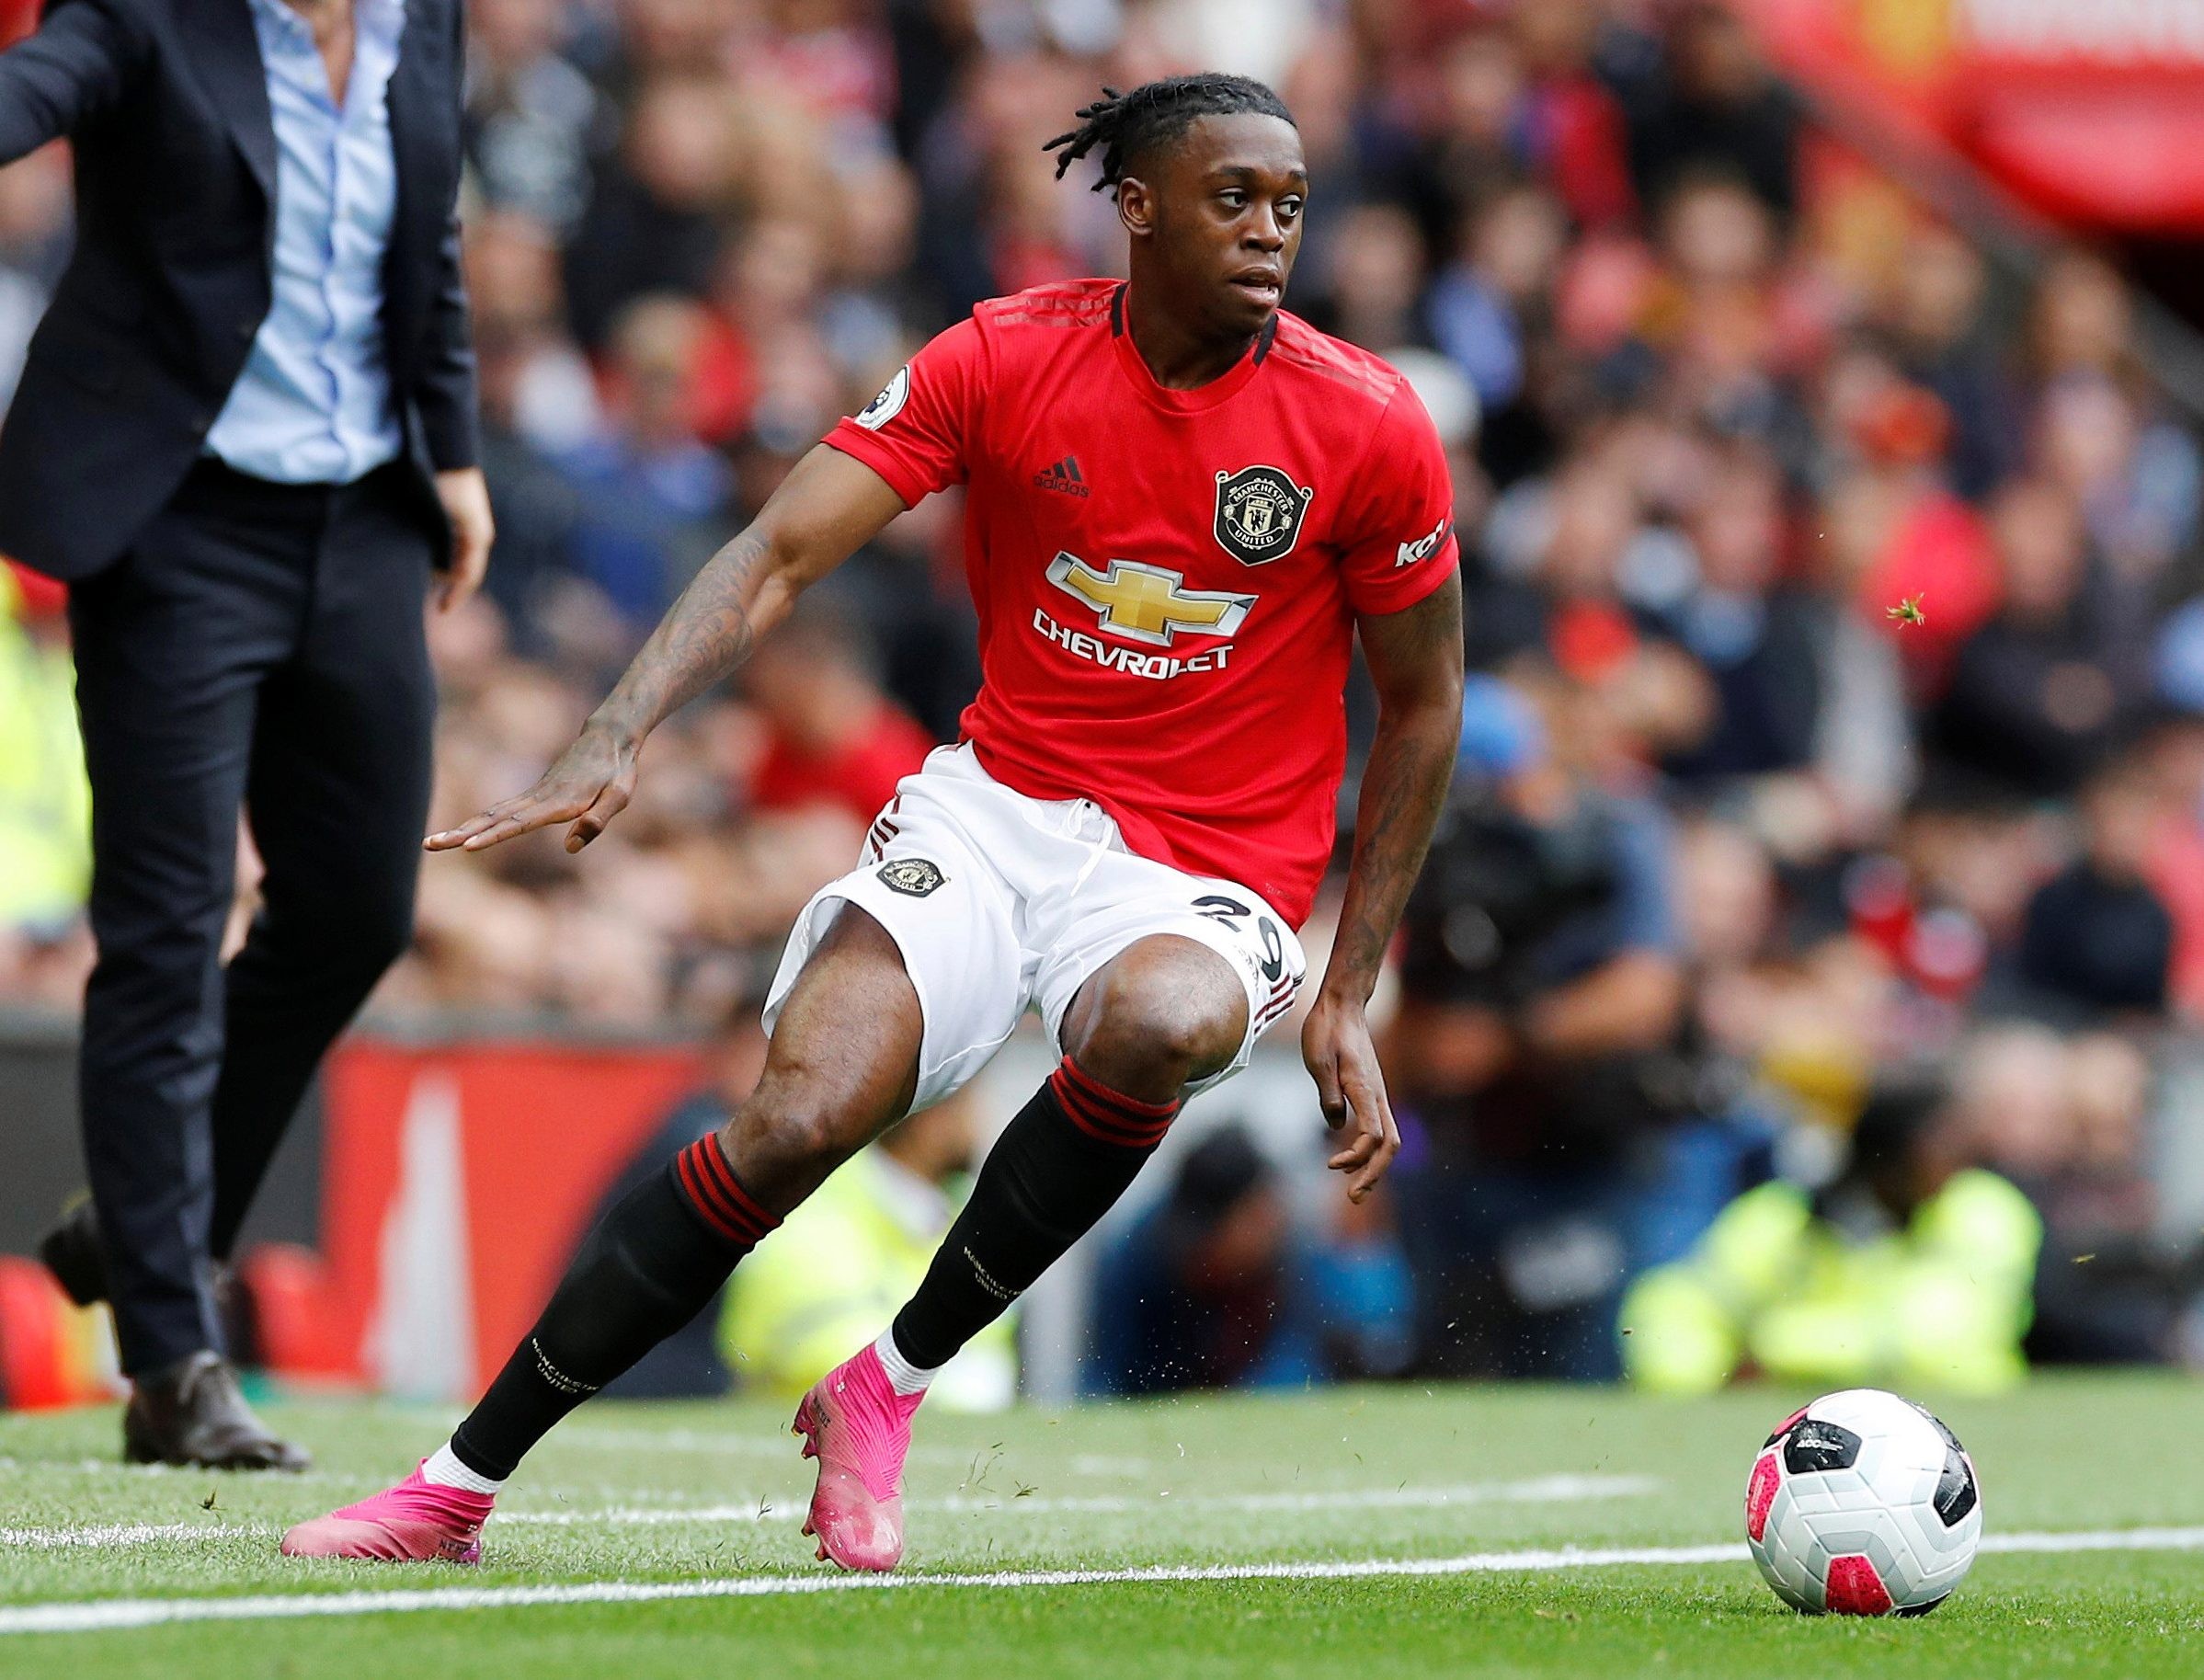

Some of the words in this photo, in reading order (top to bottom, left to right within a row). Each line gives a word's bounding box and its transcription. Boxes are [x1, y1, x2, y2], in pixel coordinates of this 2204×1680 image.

[1033, 475, 1090, 498] adidas
[1233, 483, 1288, 511] MANCHESTER
[1234, 529, 1274, 545] UNITED
[1033, 607, 1234, 680] CHEVROLET
[1190, 895, 1282, 982] 29
